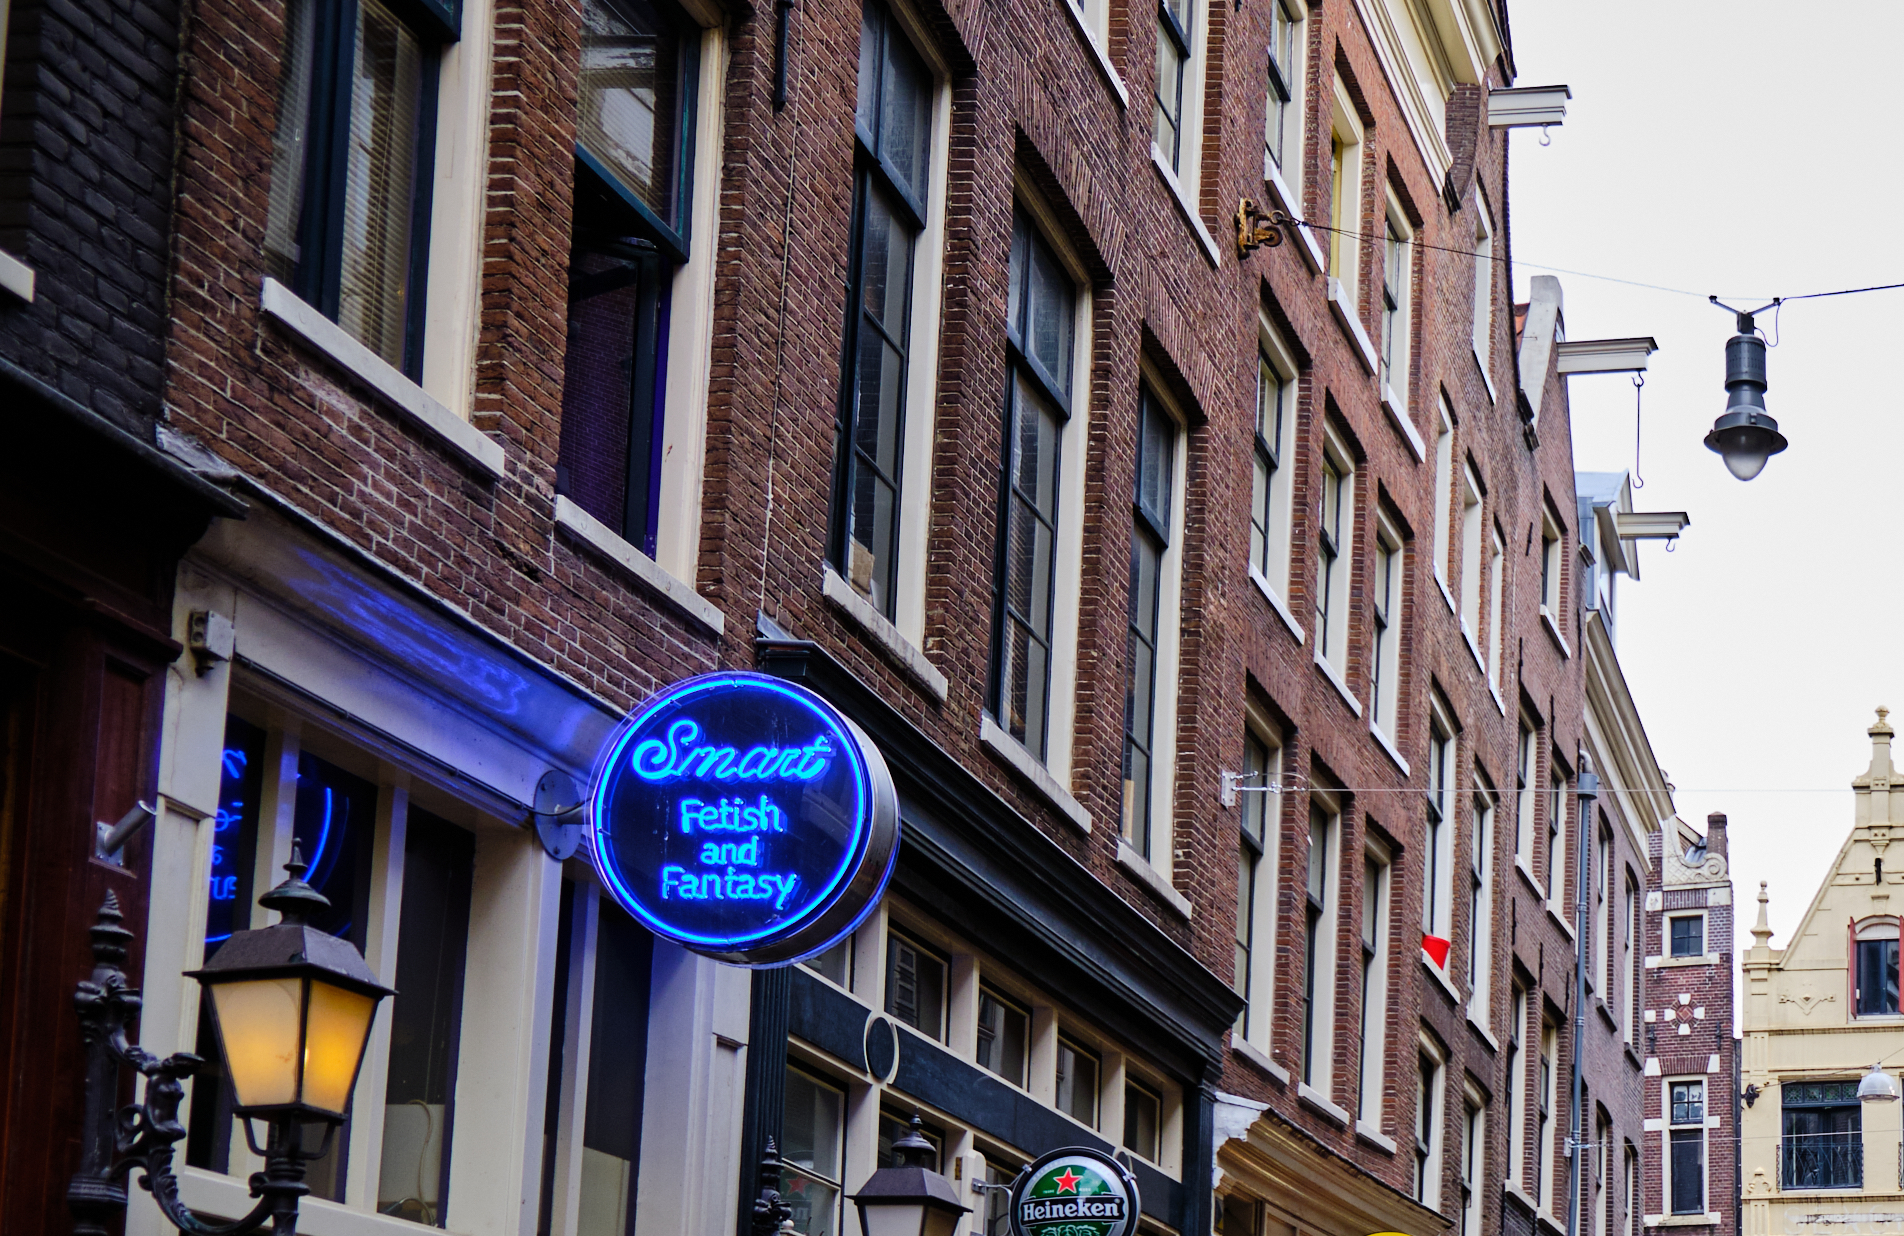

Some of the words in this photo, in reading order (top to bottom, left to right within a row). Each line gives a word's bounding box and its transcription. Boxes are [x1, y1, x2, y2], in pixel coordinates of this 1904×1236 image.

[632, 719, 832, 780] Smart
[681, 794, 784, 834] Fetish
[700, 835, 760, 866] and
[661, 865, 798, 911] Fantasy
[1023, 1198, 1120, 1222] Heineken
